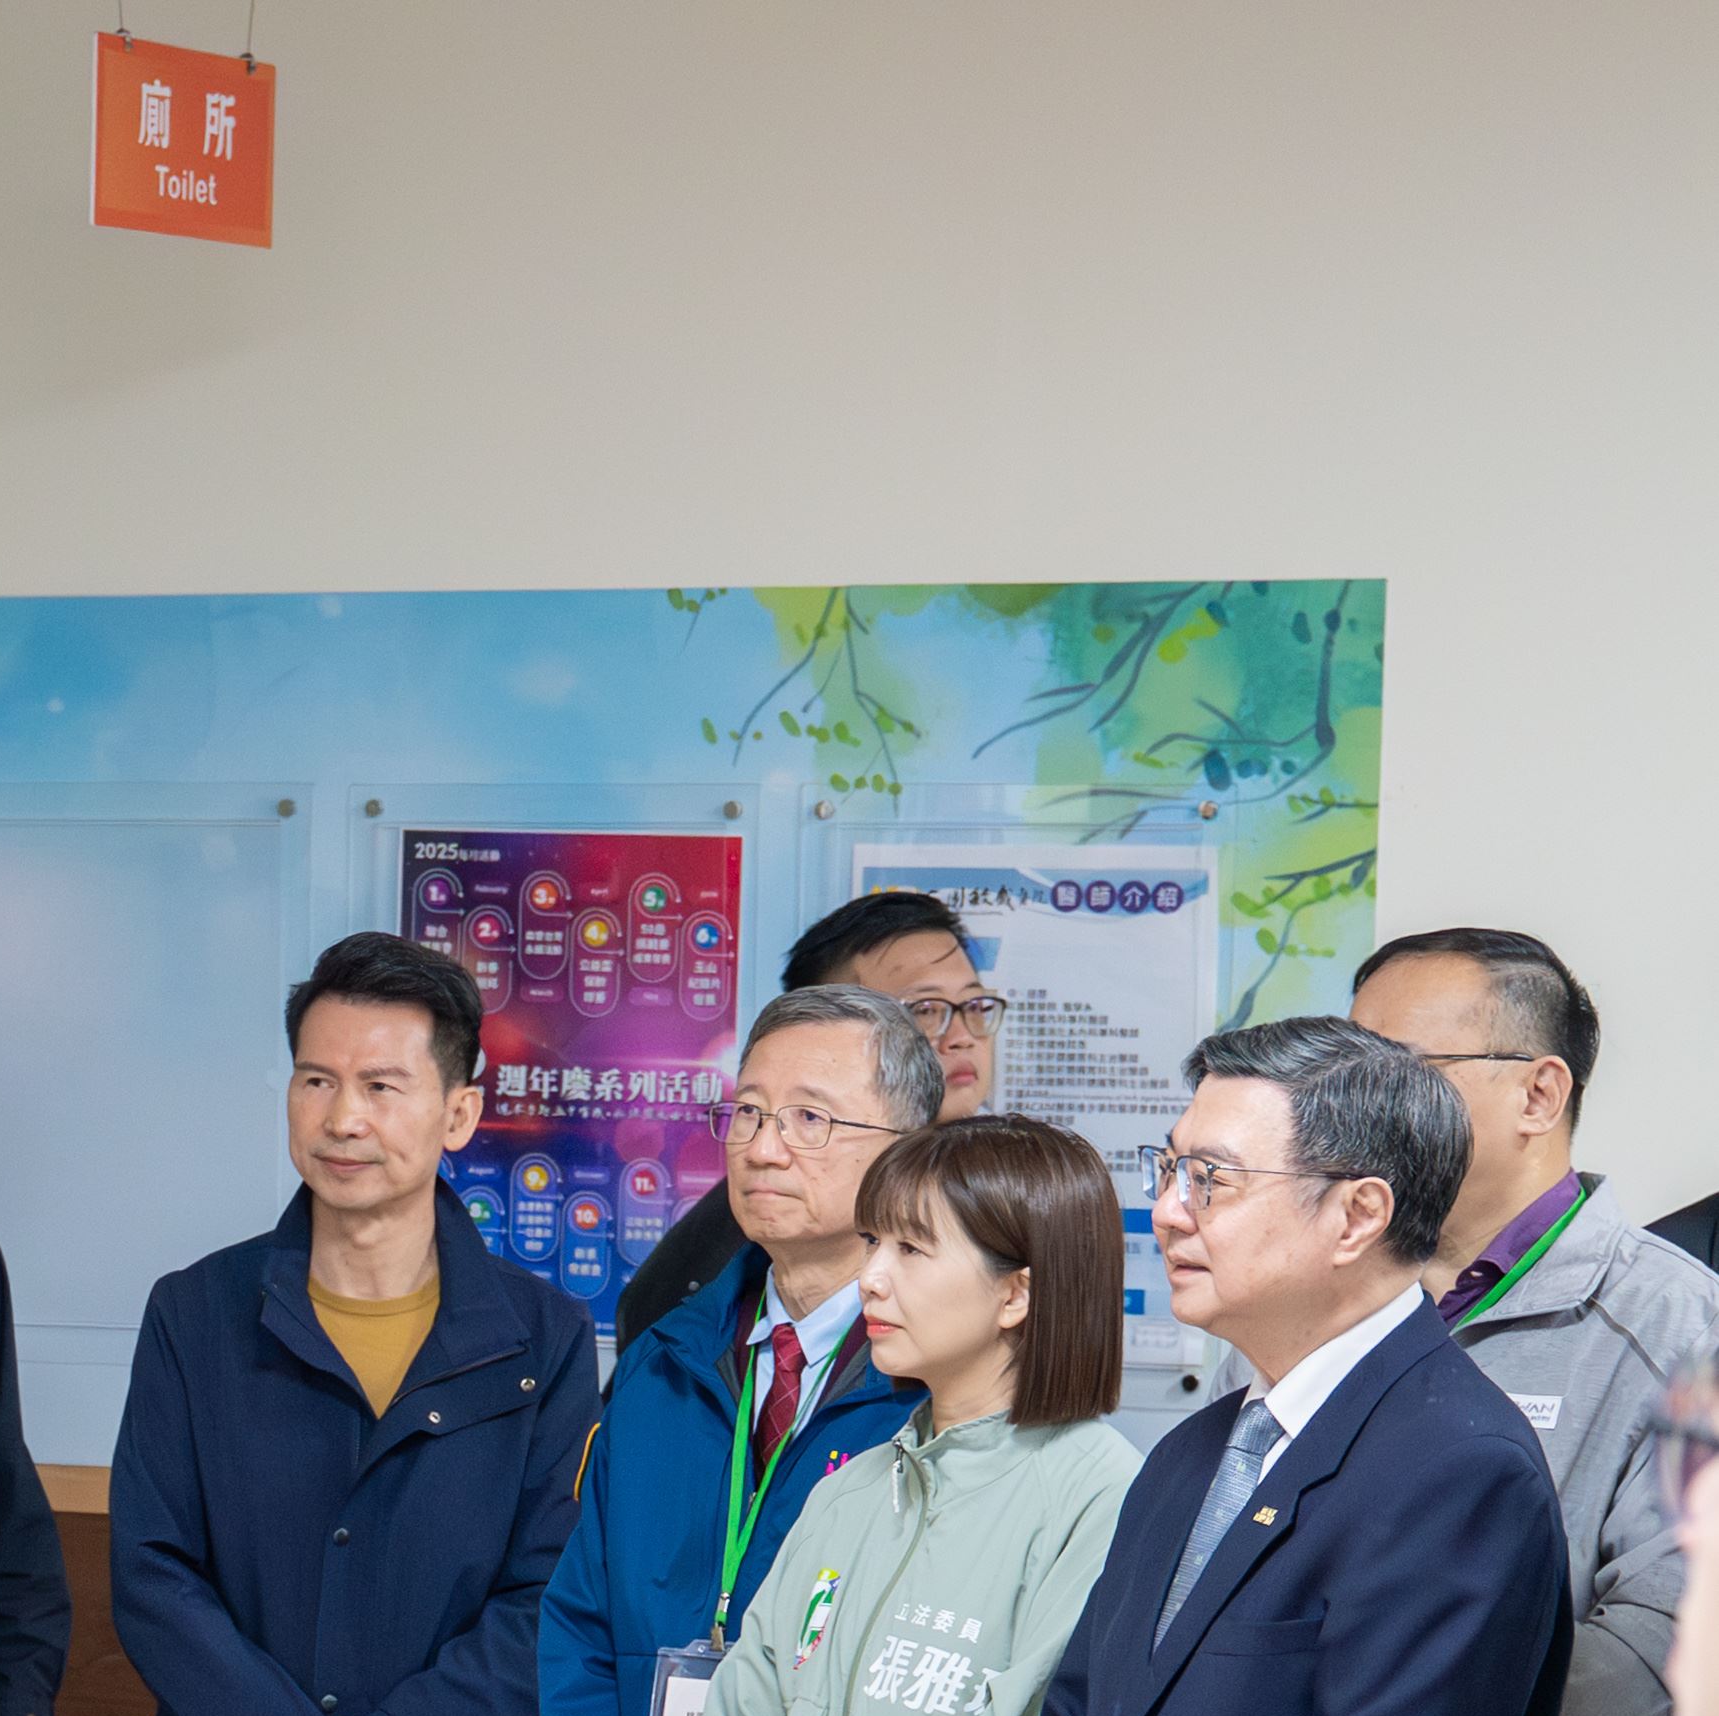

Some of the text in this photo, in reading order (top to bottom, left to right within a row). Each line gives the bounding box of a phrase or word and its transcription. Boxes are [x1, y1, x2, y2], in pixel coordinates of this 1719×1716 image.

[138, 79, 236, 161] 廁所
[154, 163, 218, 206] Toilet
[1055, 884, 1179, 909] 醫師介紹
[495, 1063, 724, 1105] 週年慶系列活動
[894, 1601, 983, 1645] 立法委員
